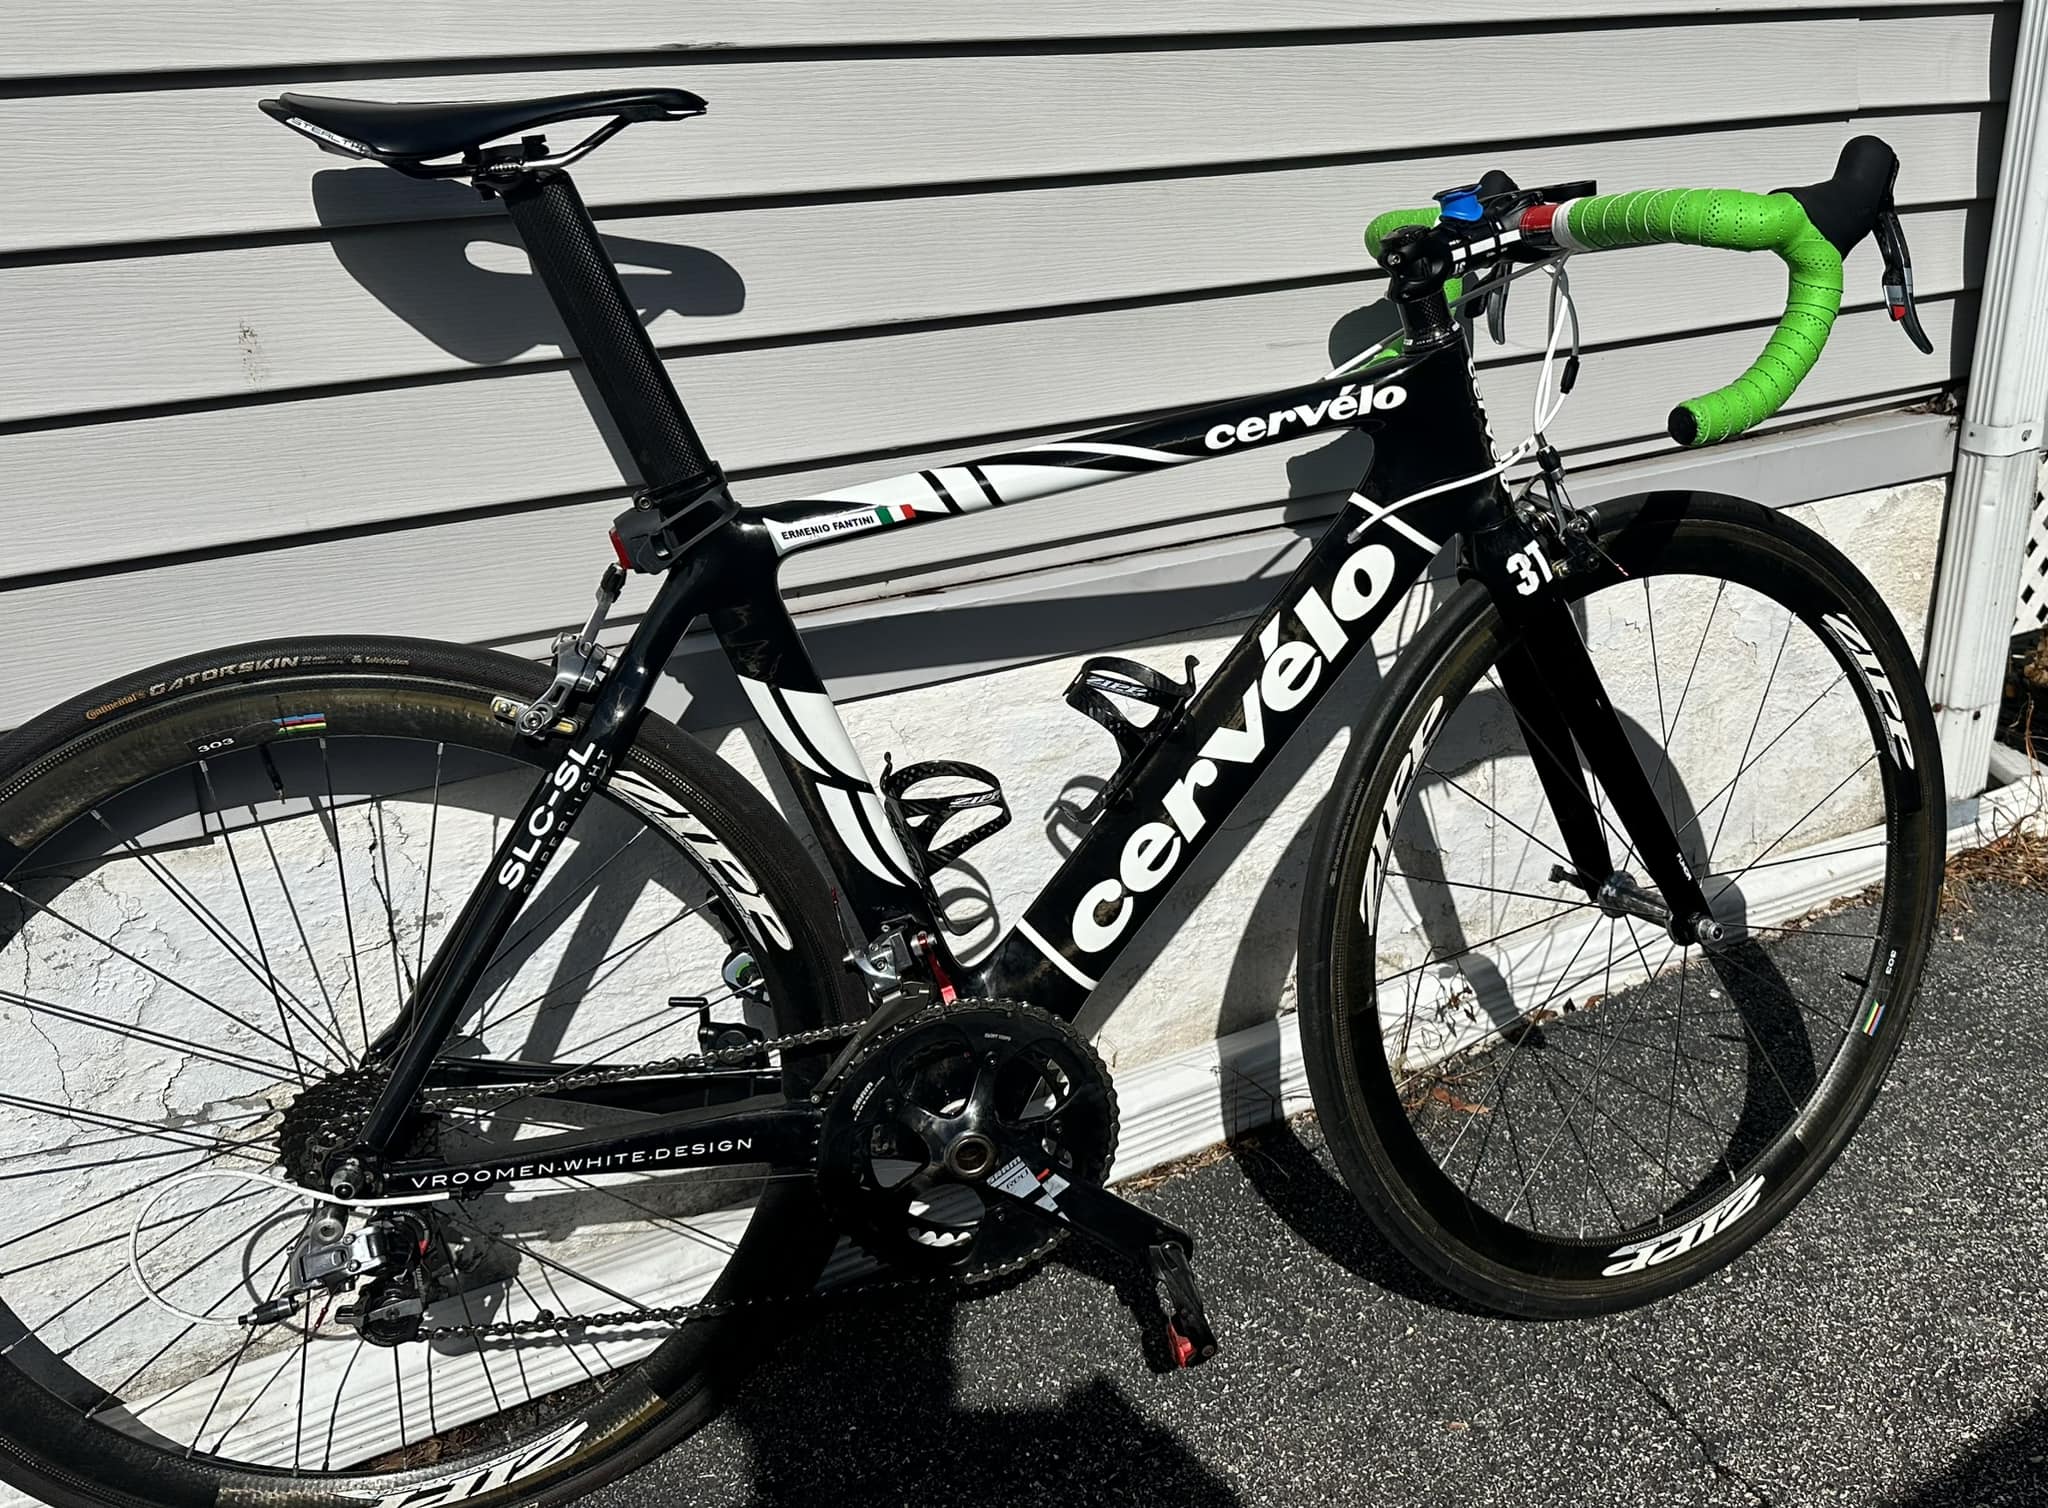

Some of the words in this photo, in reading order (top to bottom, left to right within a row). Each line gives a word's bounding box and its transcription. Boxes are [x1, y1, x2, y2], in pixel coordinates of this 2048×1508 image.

[1204, 384, 1407, 450] cervélo
[781, 525, 831, 540] ERMENIO
[833, 515, 875, 531] FANTINI
[86, 694, 137, 720] Continental
[148, 656, 300, 697] GATORSKIN
[1086, 676, 1149, 694] ZIPP
[1822, 613, 1915, 770] ZIPP
[197, 737, 235, 754] 303
[1072, 544, 1396, 954] cervélo
[498, 742, 596, 890] SLC-SL
[1359, 695, 1444, 936] ZIPP
[607, 770, 794, 951] ZIPP
[1885, 950, 1897, 975] 303
[1601, 1174, 1766, 1277] ZIPP
